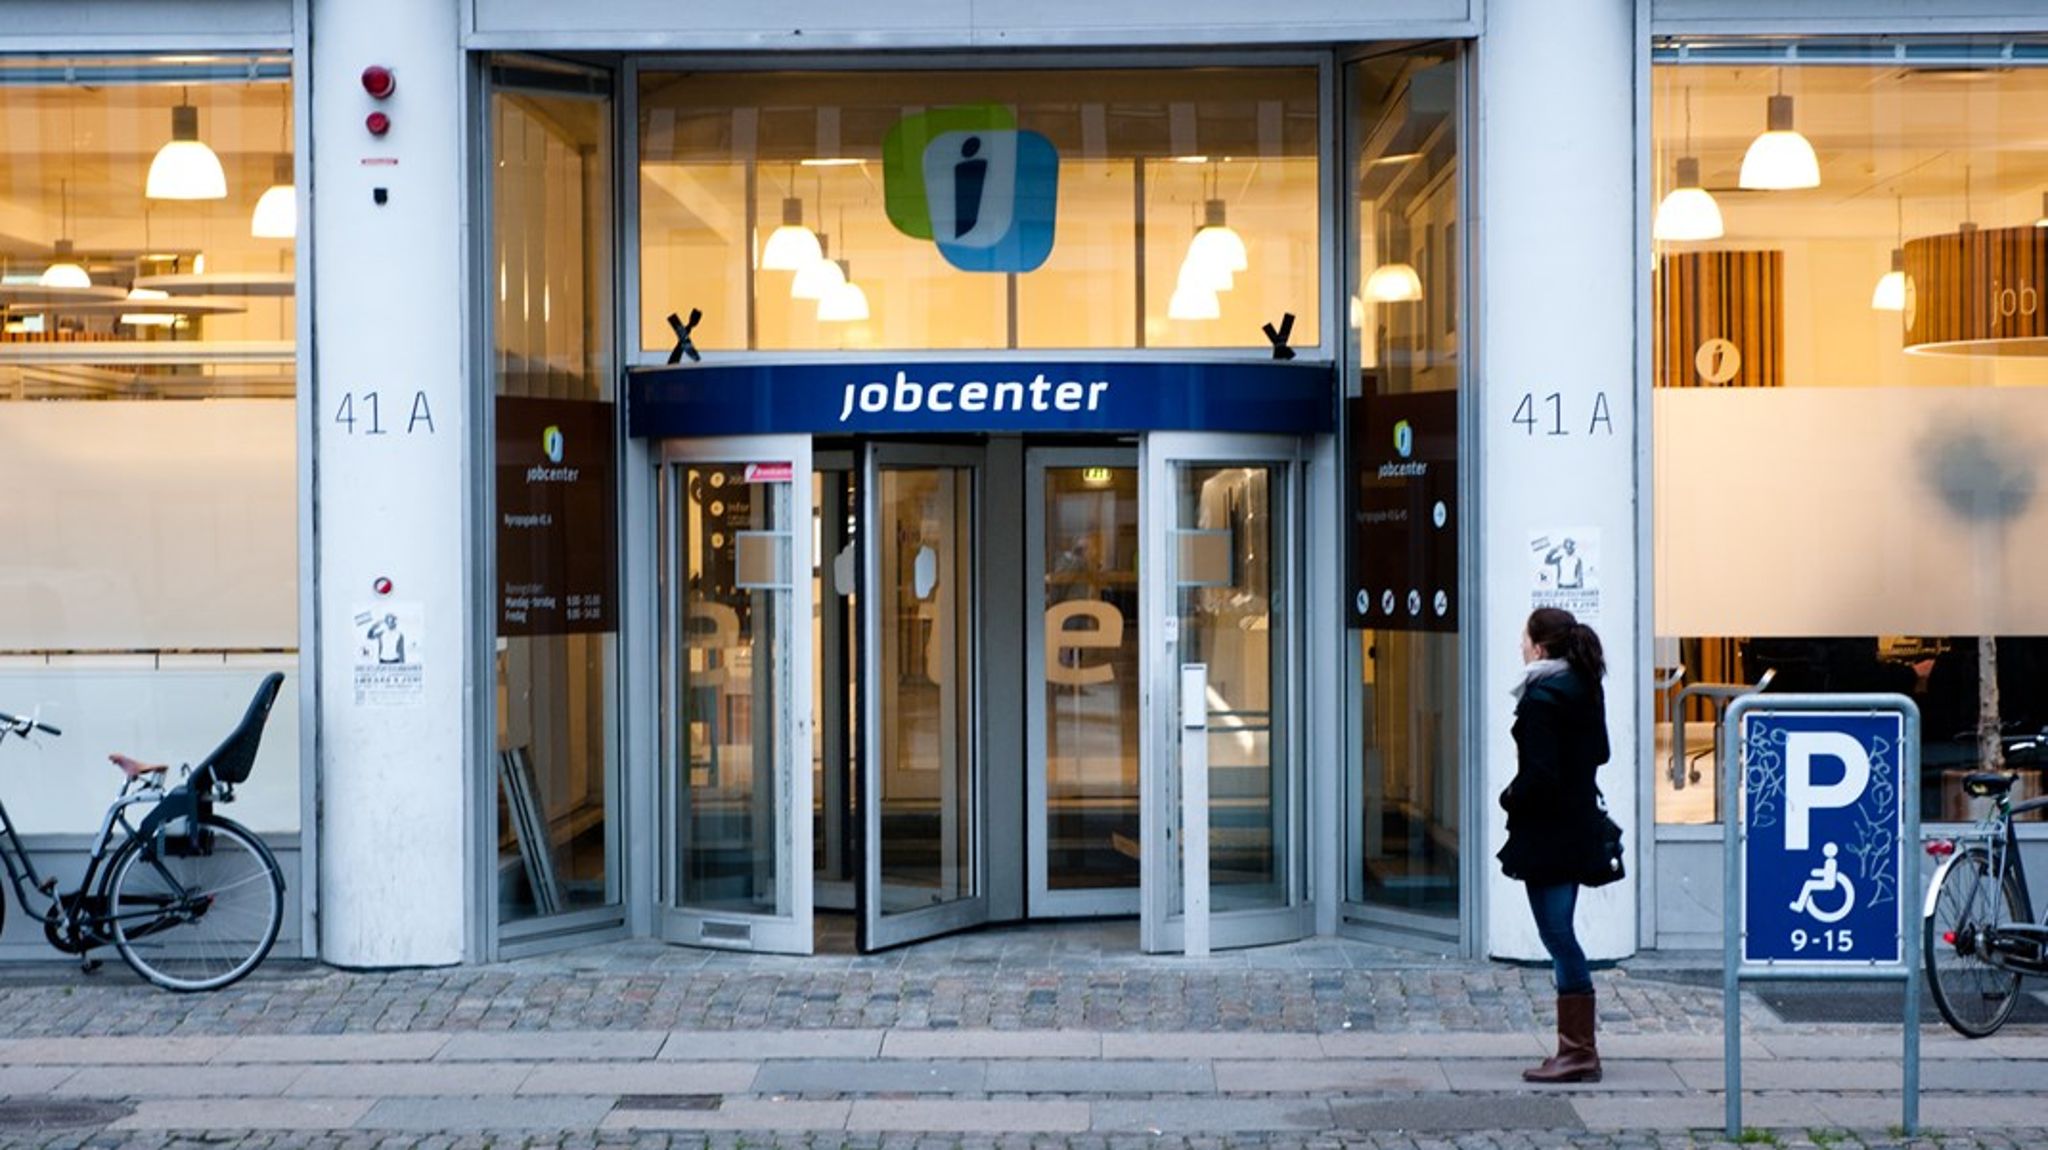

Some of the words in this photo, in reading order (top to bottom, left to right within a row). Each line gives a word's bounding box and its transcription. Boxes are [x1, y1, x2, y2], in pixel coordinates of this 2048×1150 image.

[1991, 278, 2037, 328] job
[335, 391, 387, 435] 41
[407, 390, 435, 434] A
[839, 371, 1109, 422] jobcenter
[1512, 392, 1569, 435] 41
[1588, 391, 1613, 435] A
[526, 464, 579, 485] jobcenter
[1377, 460, 1428, 481] jobcenter
[1784, 731, 1870, 850] P
[1790, 929, 1854, 952] 9-15
